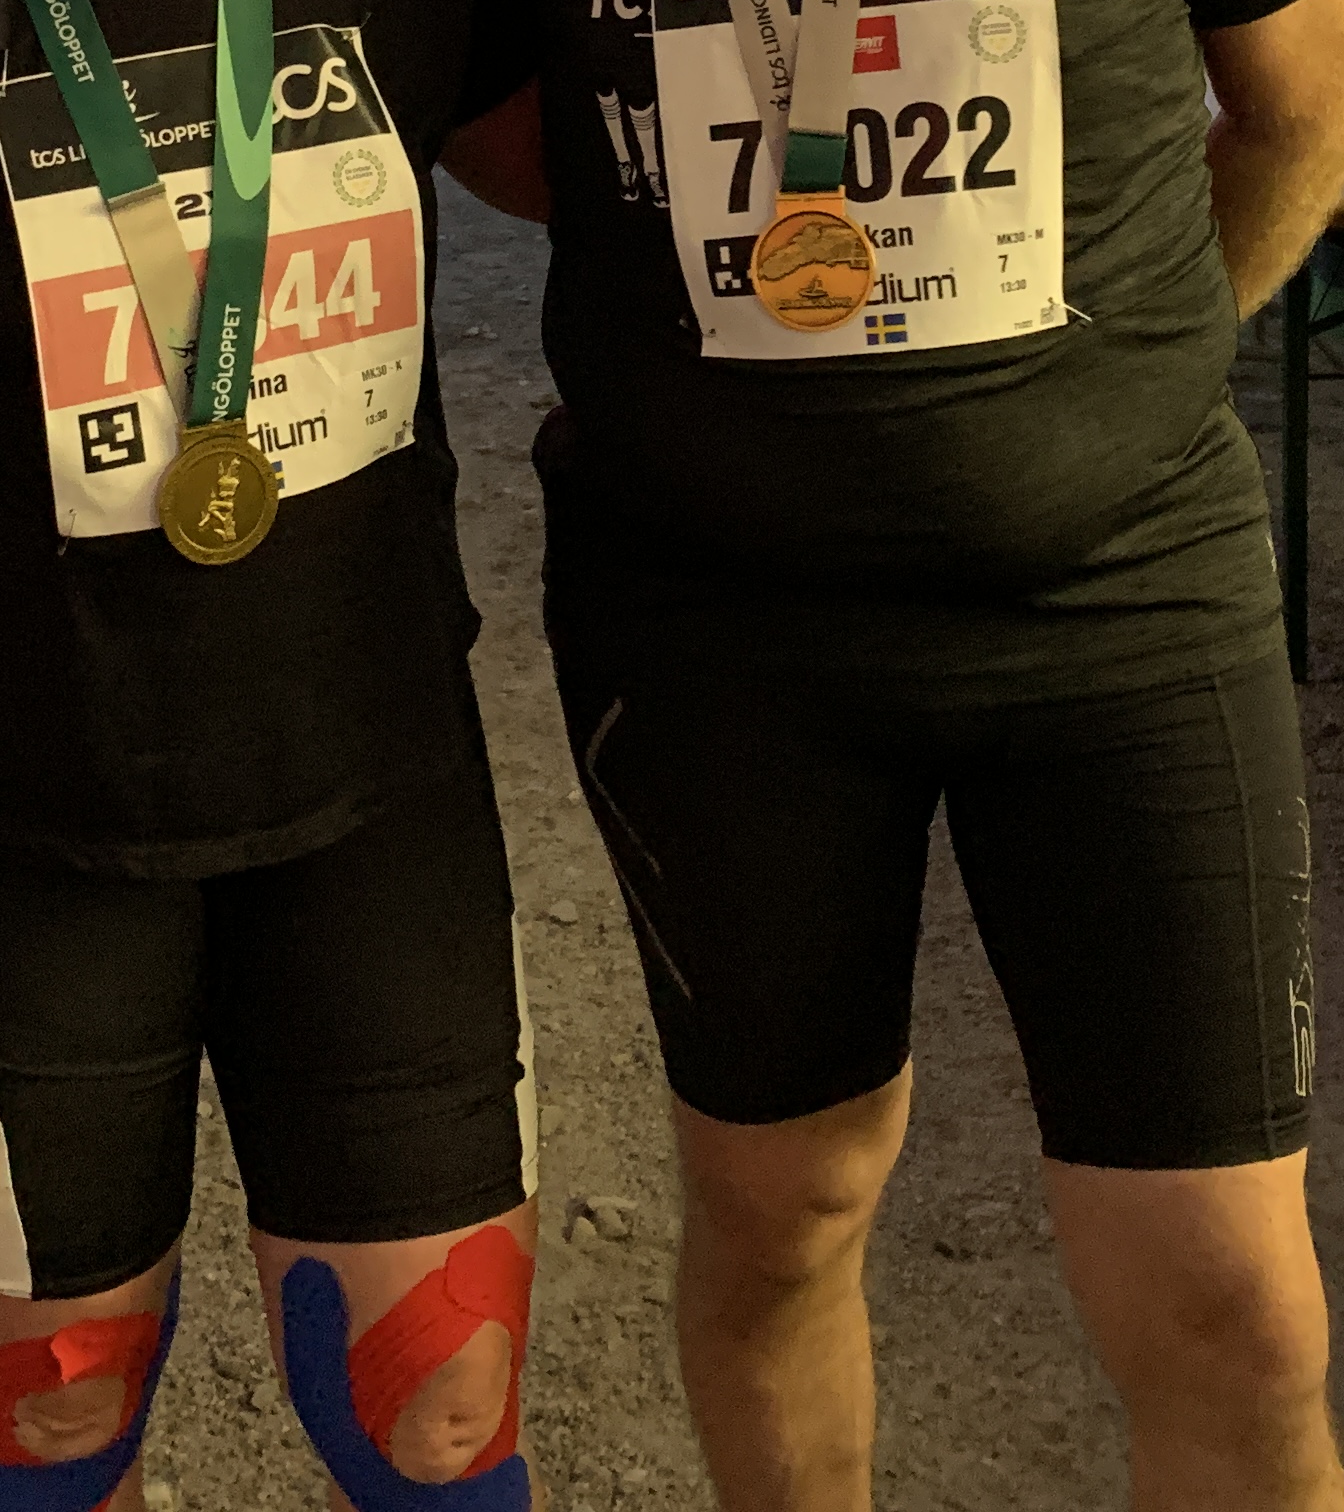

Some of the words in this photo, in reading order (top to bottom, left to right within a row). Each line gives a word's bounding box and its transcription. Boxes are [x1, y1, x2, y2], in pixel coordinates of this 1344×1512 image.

[272, 56, 357, 125] cs
[30, 147, 66, 169] tcs
[709, 95, 1016, 215] 7022
[998, 254, 1009, 273] 7
[364, 389, 374, 408] 7
